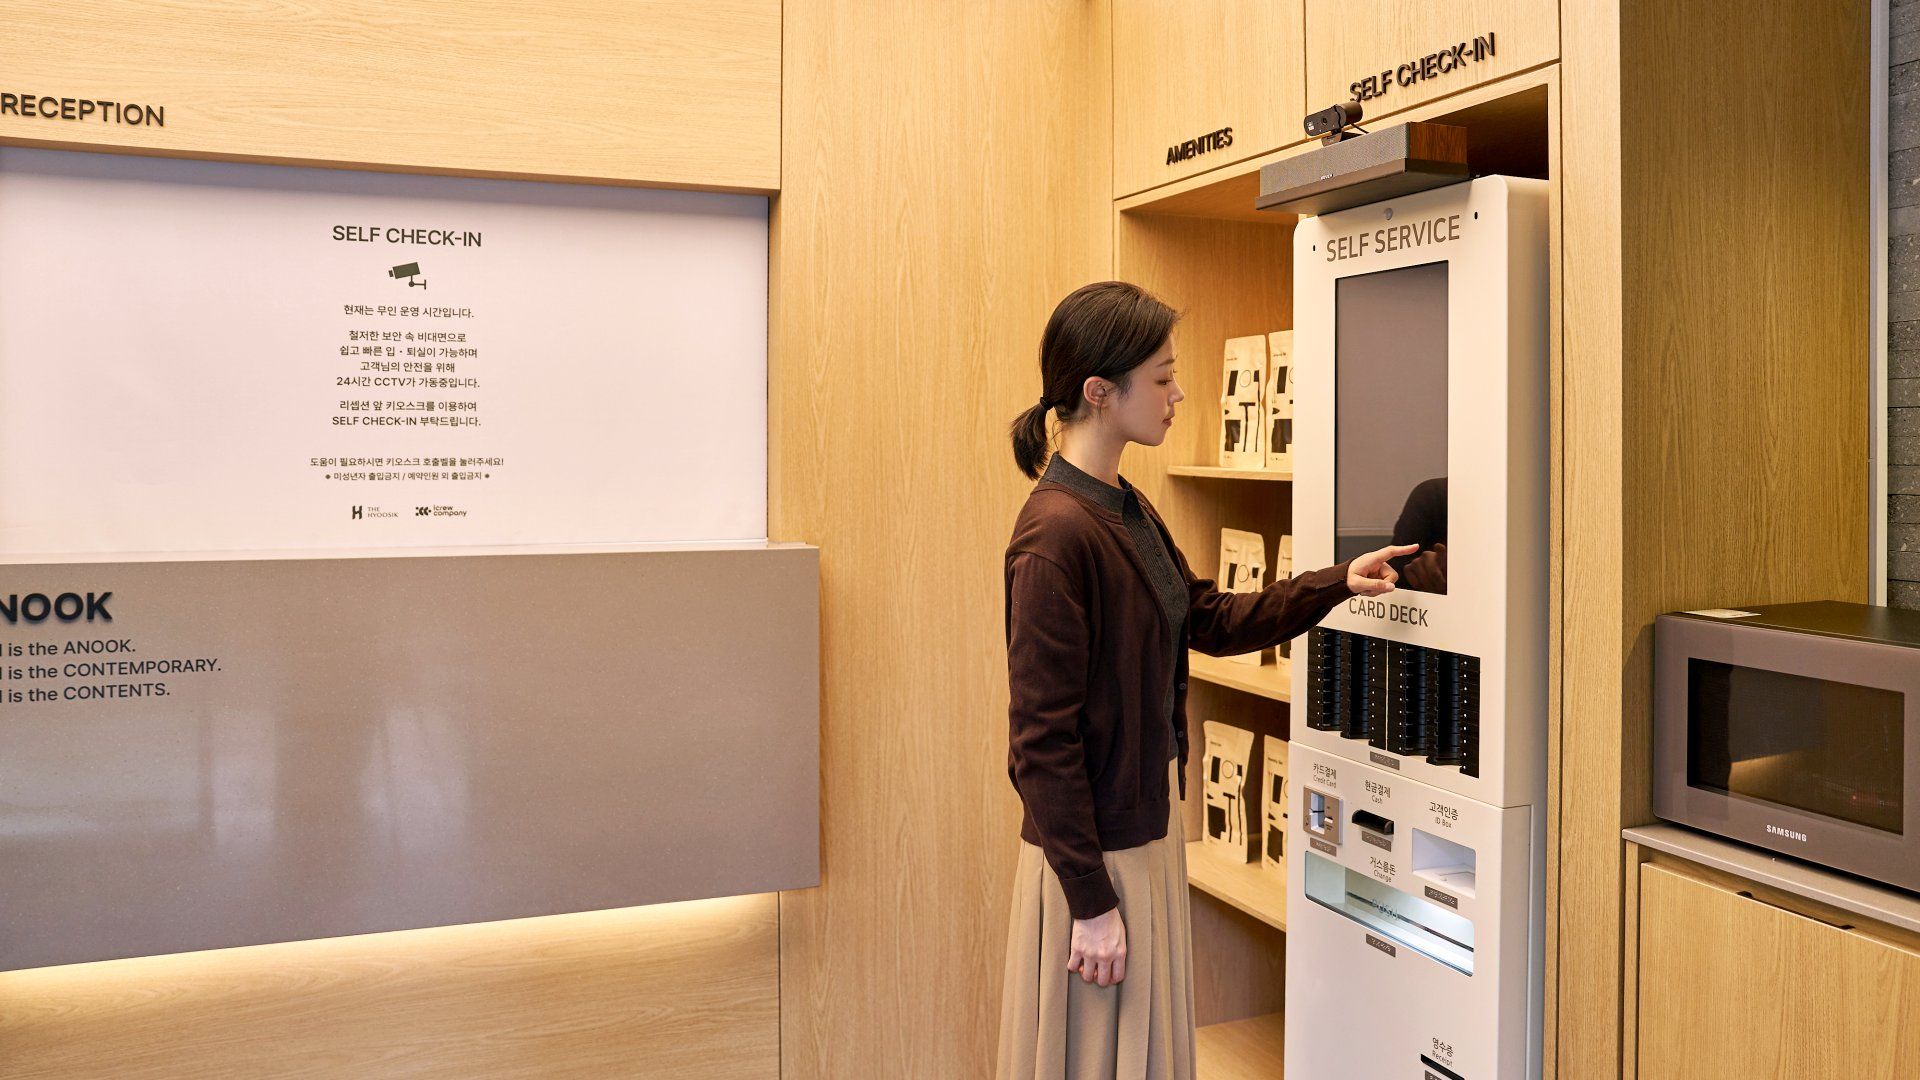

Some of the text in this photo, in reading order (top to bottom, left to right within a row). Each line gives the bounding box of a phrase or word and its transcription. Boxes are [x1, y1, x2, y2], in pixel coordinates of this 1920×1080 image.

[1349, 32, 1496, 103] SELF CHECK-IN
[1, 93, 164, 127] RECEPTION
[1166, 127, 1233, 166] AMENITIES
[333, 225, 481, 247] SELF CHECK-IN
[1326, 214, 1461, 262] SELF SERVICE
[344, 305, 474, 318] 현재는 무인 운영 시간입니다.
[349, 331, 466, 342] 철저한 보안 속 비대면으로
[340, 346, 359, 355] 쉽고
[363, 346, 382, 356] 빠른
[386, 347, 394, 356] 입
[407, 347, 435, 357] 퇴실이
[439, 348, 477, 358] 가능하며
[361, 362, 454, 373] 고객님의 안전을 위해
[337, 377, 480, 388] 24시간 CCTV가 가동중입니다.
[340, 401, 476, 411] 리셉션 앞 키오스크를 이용하여
[333, 417, 481, 426] SELF CHECK-IN 부탁드립니다.
[311, 458, 503, 466] 도움이 필요하시면 키오스크 호출벨을 눌러주세요!
[334, 472, 366, 480] 미성년자
[369, 472, 399, 480] 출입금지
[452, 472, 481, 480] 출입금지
[1348, 597, 1429, 627] CARD DECK
[9, 643, 22, 656] is
[28, 642, 58, 656] the
[63, 639, 135, 654] ANOOK.
[9, 666, 22, 679] is
[28, 665, 57, 679] the
[64, 659, 221, 677] CONTEMPORARY.
[9, 689, 23, 703] is
[28, 688, 58, 701] the
[64, 683, 170, 700] CONTENTS.
[1312, 763, 1337, 780] 카드결제
[1364, 779, 1391, 799] 현금결제
[1371, 794, 1383, 805] Cash
[1429, 801, 1459, 821] 고객인증
[1766, 824, 1808, 842] SAMSUNG
[1373, 869, 1392, 883] Change
[1432, 1037, 1454, 1058] 영수증
